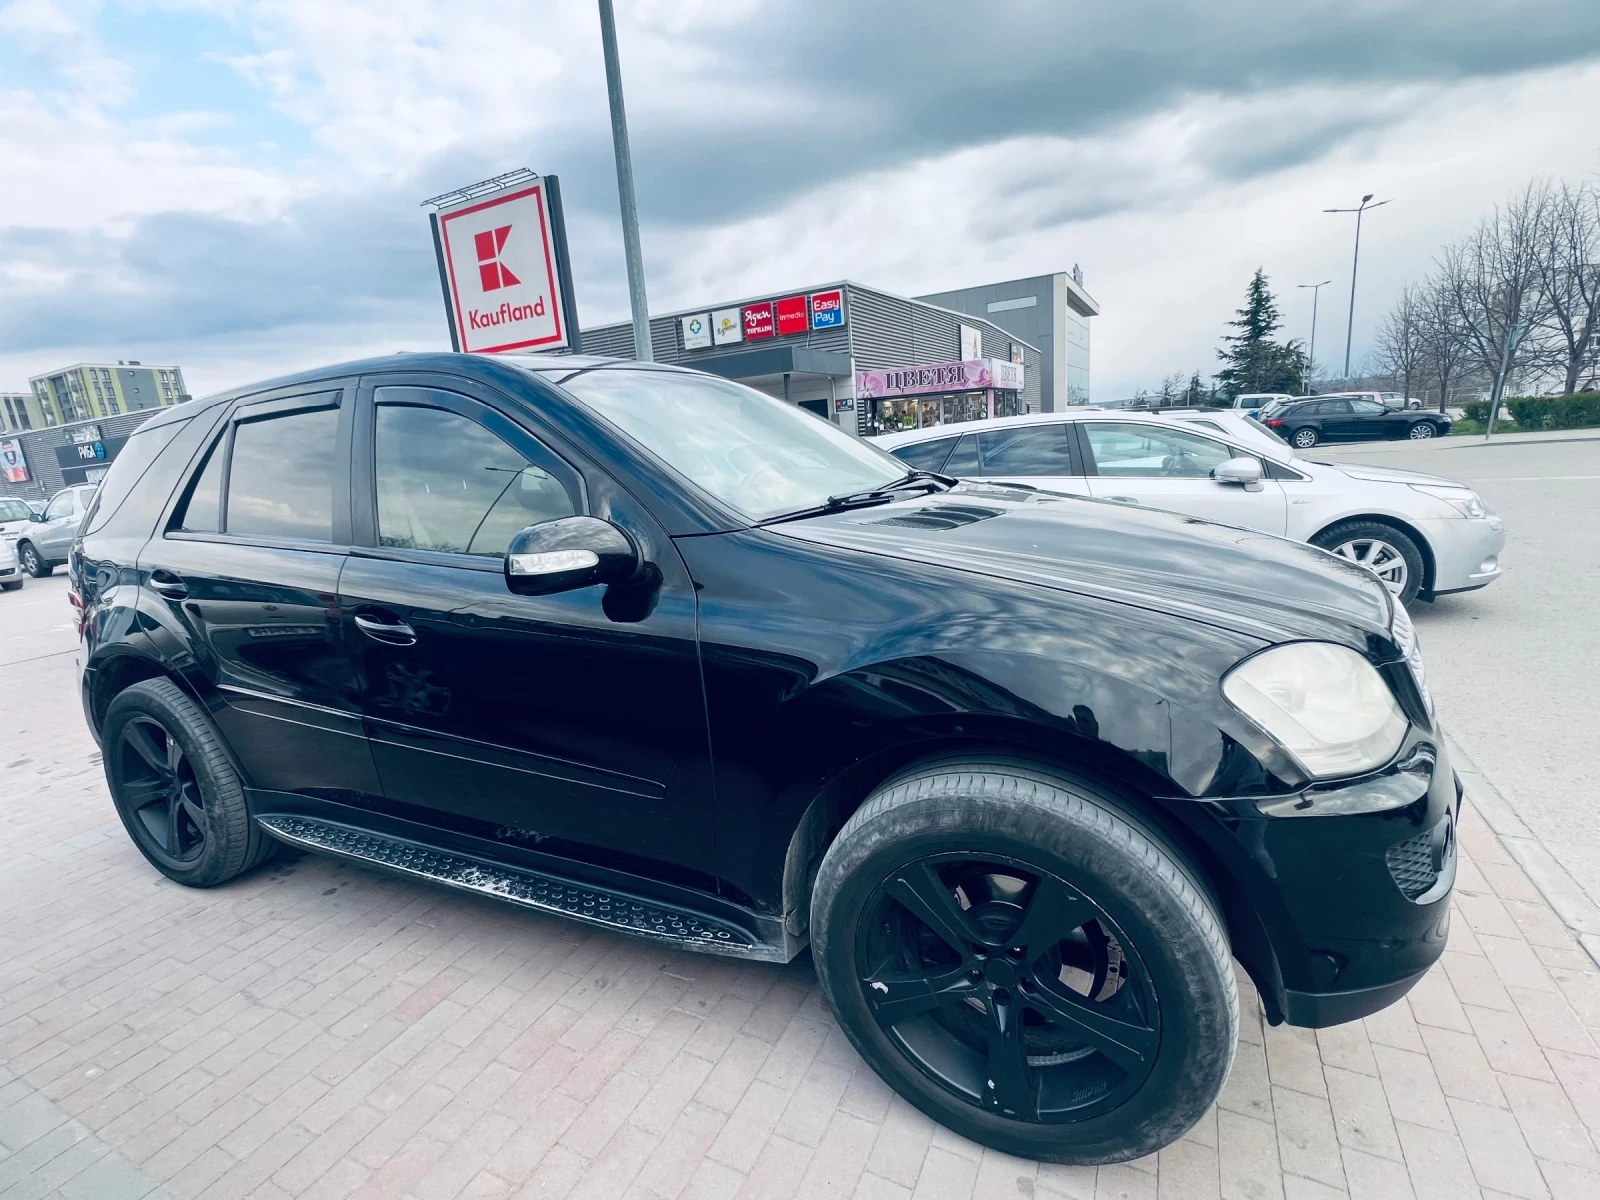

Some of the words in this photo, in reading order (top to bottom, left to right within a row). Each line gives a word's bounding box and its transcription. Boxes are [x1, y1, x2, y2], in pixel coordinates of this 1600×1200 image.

[813, 299, 839, 311] Easy
[469, 295, 545, 330] Kaufland
[815, 312, 835, 323] Pay
[884, 364, 966, 393] ЦВЕТЯ
[78, 445, 96, 459] РИБА
